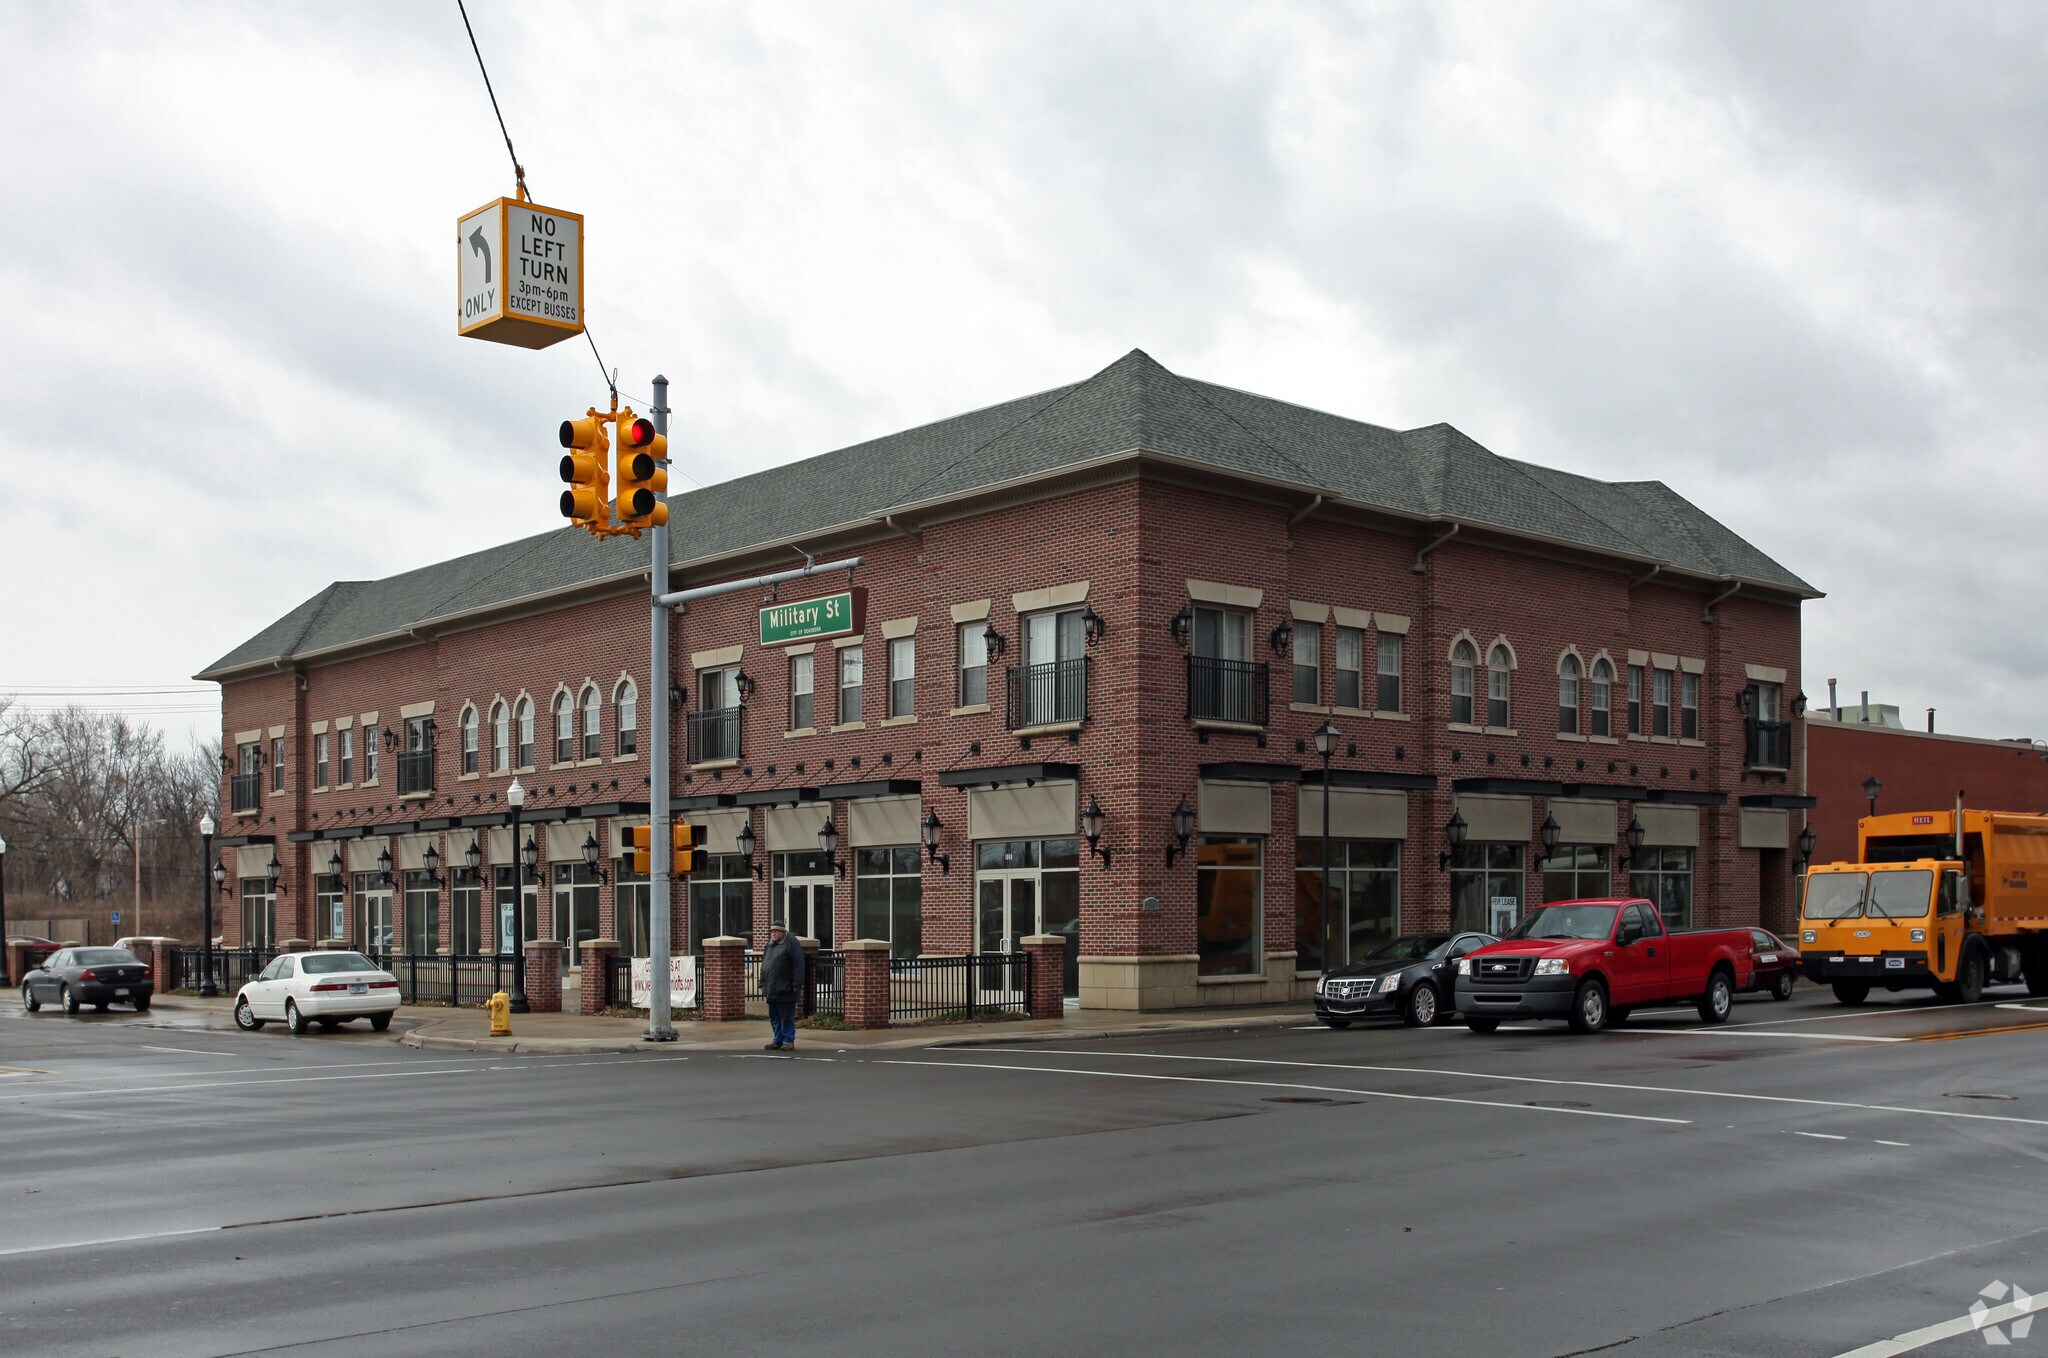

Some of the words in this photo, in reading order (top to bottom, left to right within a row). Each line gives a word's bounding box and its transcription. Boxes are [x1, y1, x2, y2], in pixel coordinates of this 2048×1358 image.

[531, 214, 556, 237] NO
[521, 235, 566, 262] LEFT
[519, 257, 568, 285] TURN
[465, 288, 496, 319] ONLY
[518, 280, 569, 302] 3pm-6pm
[510, 295, 541, 313] EXCEPT
[544, 302, 576, 320] BUSSES
[770, 606, 818, 628] Military
[826, 600, 840, 619] St
[1913, 816, 1931, 824] HEIL
